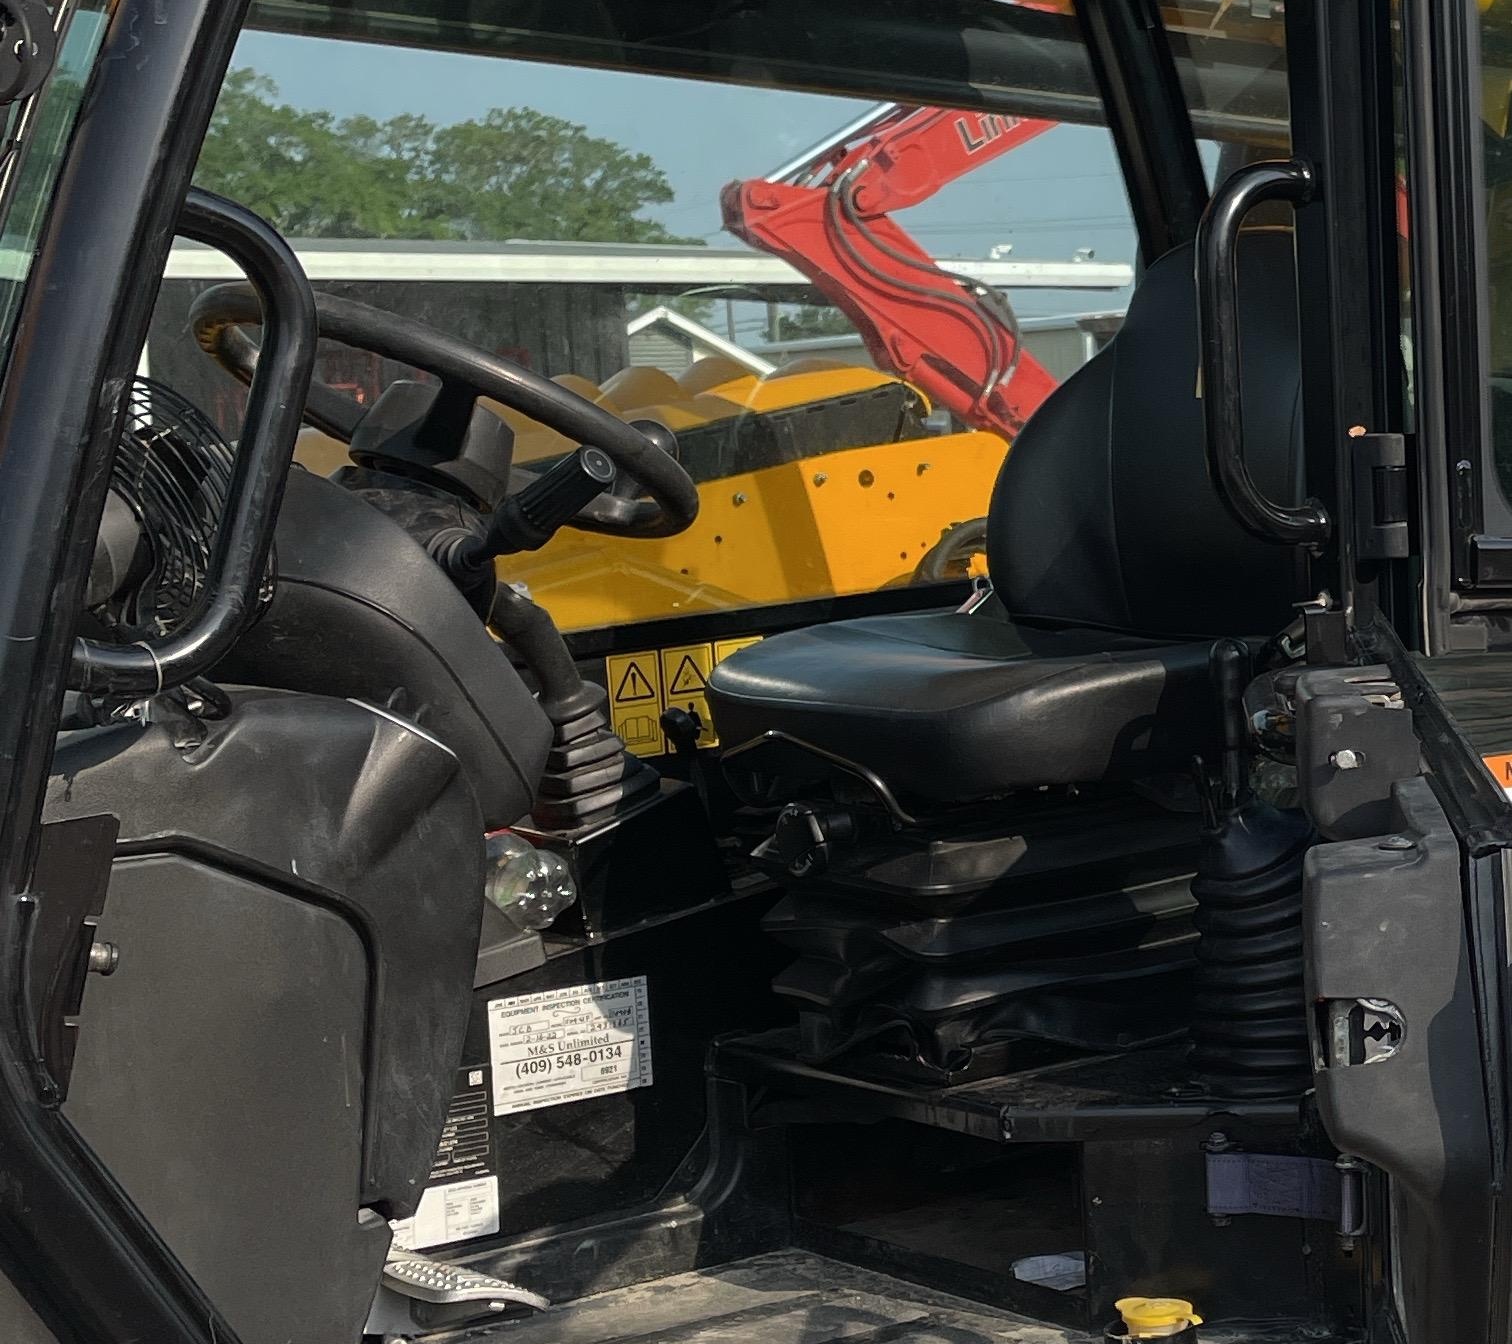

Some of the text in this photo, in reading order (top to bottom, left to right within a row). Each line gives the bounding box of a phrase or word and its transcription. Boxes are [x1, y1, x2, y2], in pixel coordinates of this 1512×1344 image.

[954, 113, 1029, 155] Lin
[527, 1043, 555, 1057] M&S
[558, 1033, 610, 1052] Unlimited
[516, 1046, 622, 1080] (409) 548-0134
